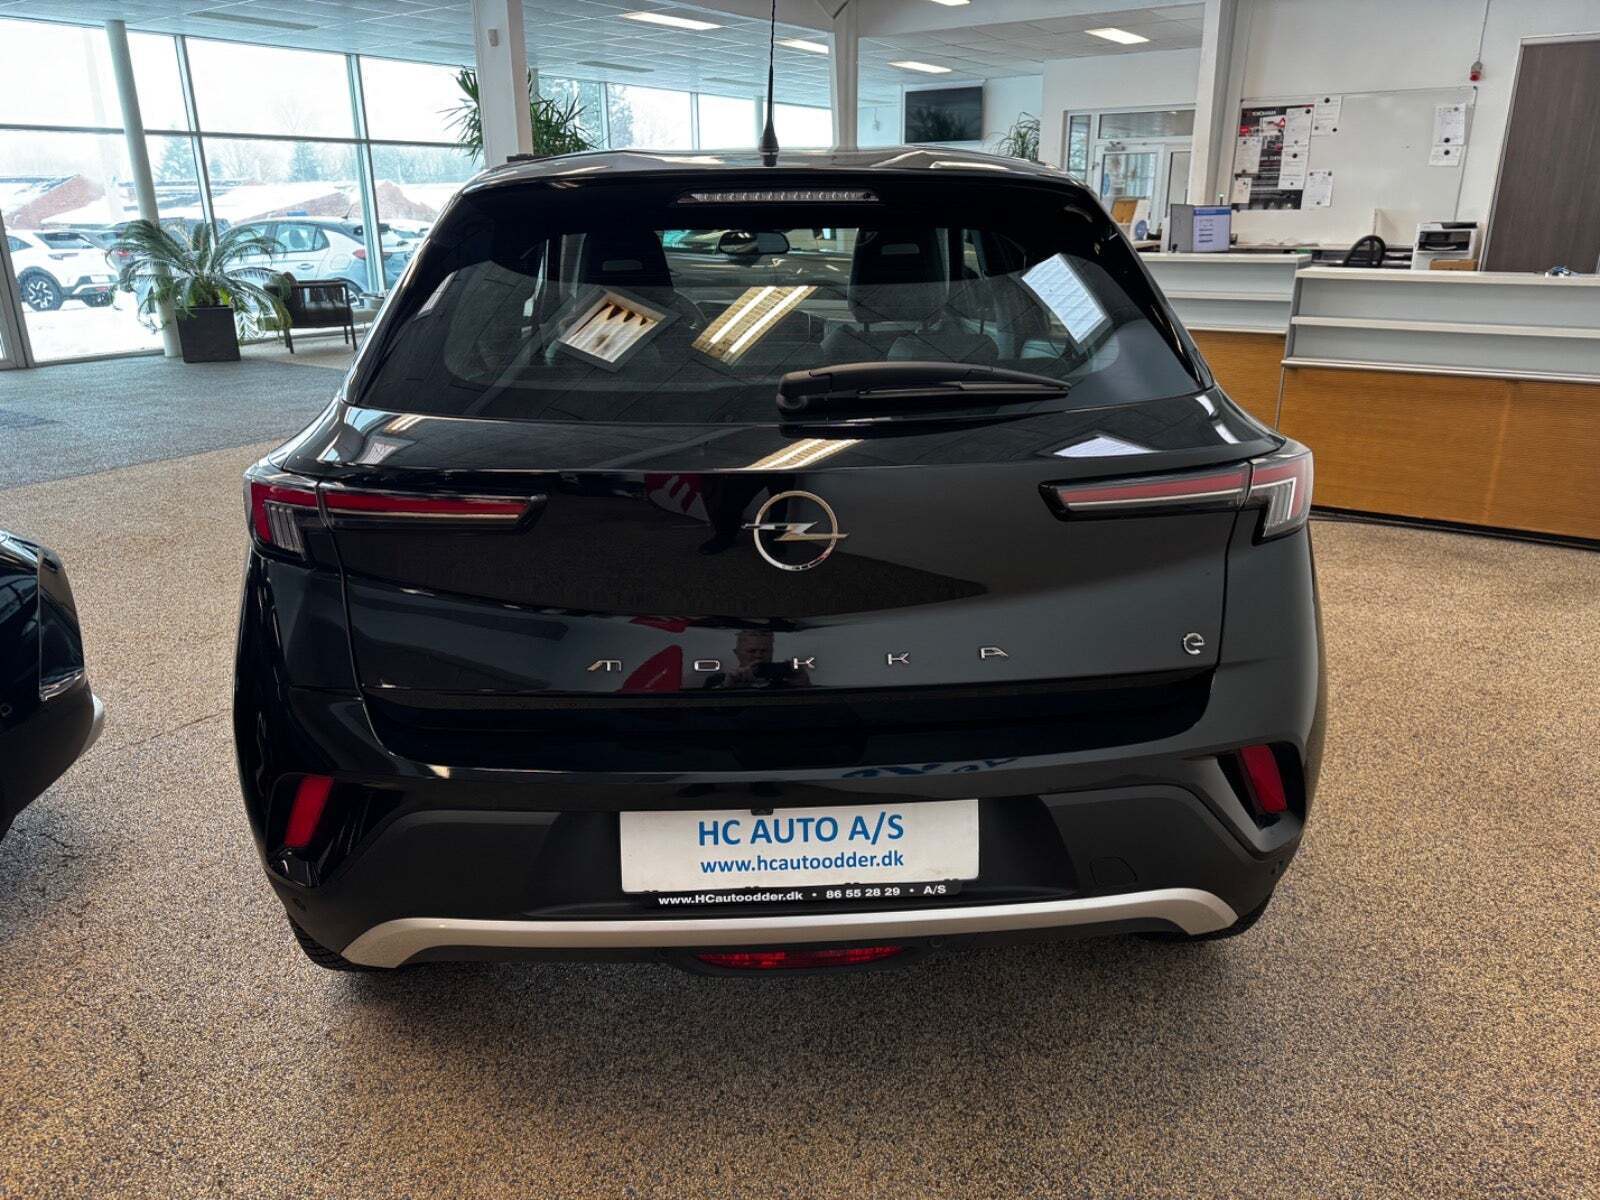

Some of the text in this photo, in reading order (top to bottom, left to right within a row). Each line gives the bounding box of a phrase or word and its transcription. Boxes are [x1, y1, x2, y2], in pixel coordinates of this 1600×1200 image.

[588, 646, 1009, 671] MOKKA
[698, 811, 904, 847] HC AUTO A/S
[700, 850, 904, 874] www.hcautoodder.dk
[658, 884, 946, 905] www.HCautoodder.dk 86 55 28 29 A/S
